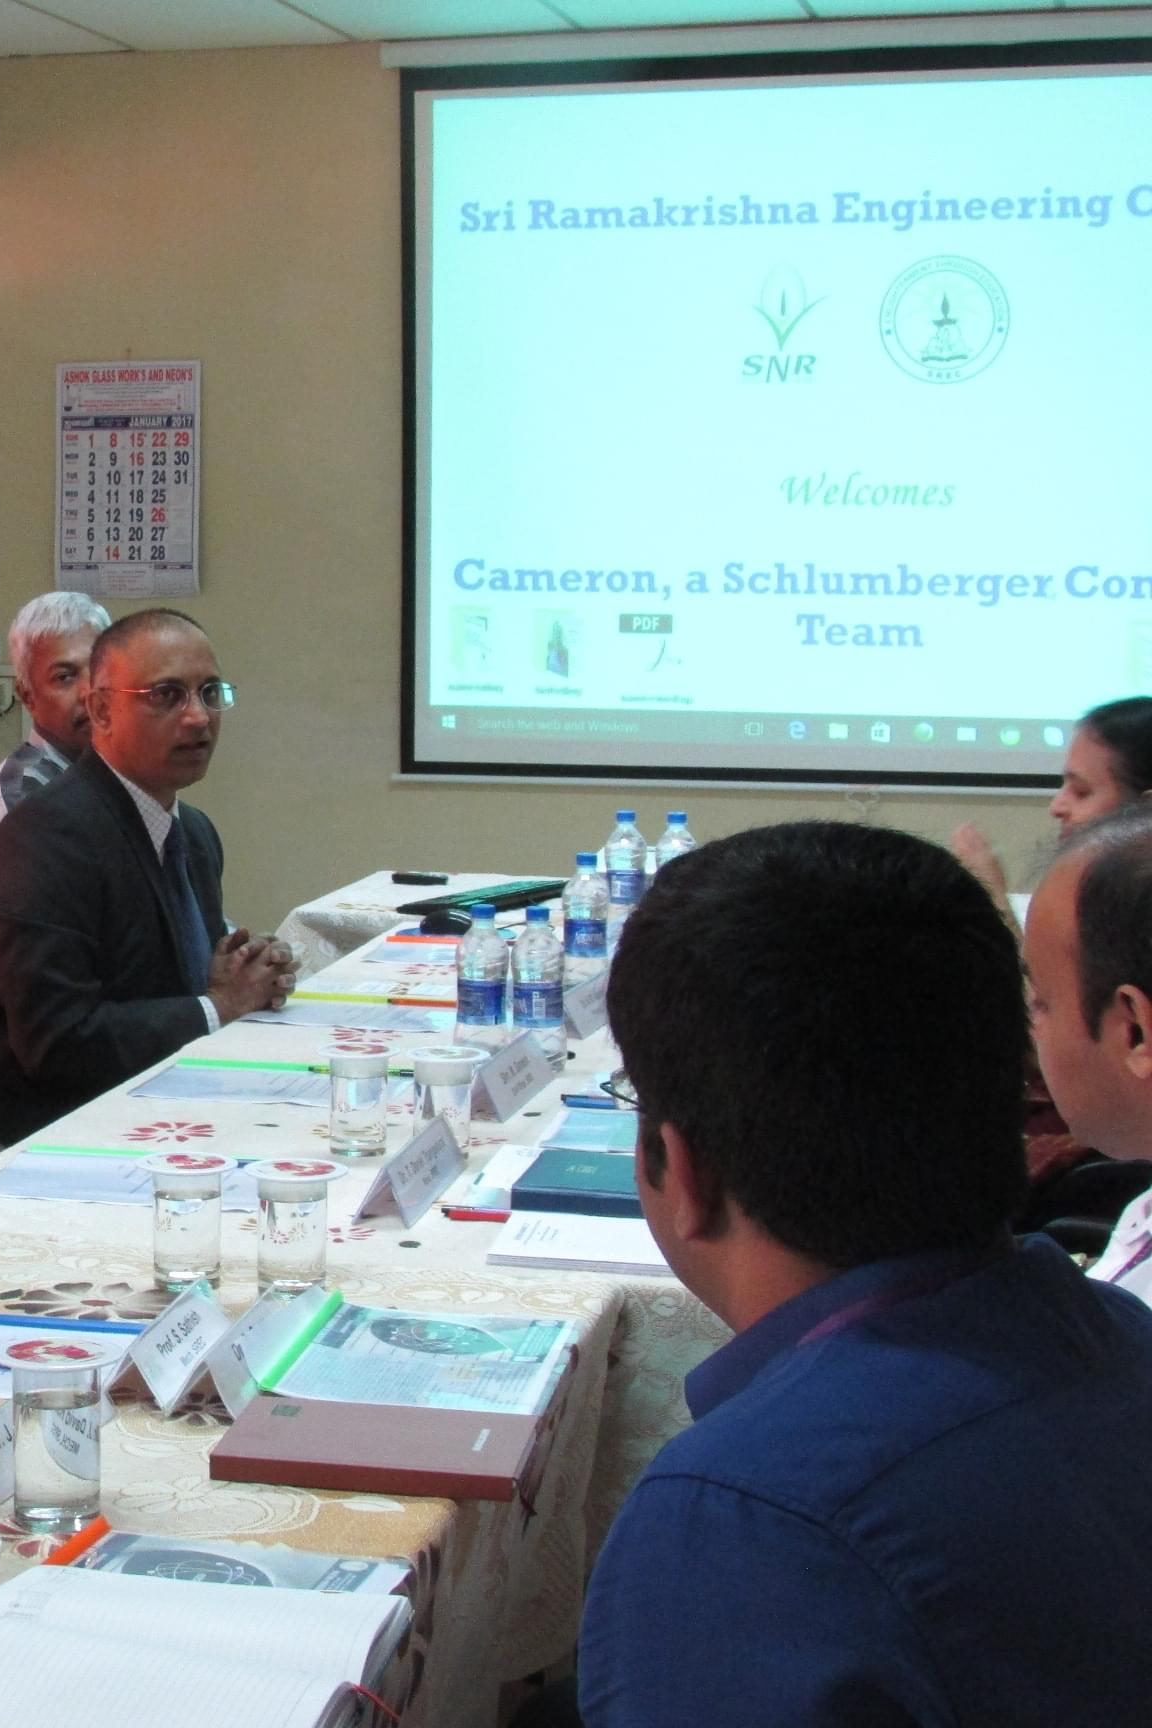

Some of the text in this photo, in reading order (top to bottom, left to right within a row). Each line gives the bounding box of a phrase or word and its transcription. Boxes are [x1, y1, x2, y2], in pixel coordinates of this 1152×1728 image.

[460, 200, 516, 232] Sri
[528, 195, 819, 230] Ramakrishna
[832, 186, 1113, 232] Engineering
[64, 370, 90, 384] ASHOK
[92, 369, 116, 383] GLASS
[148, 368, 164, 382] AND
[741, 354, 817, 383] SNR
[129, 416, 168, 428] JANUARY
[171, 416, 192, 427] 2017
[89, 433, 93, 448] 1
[110, 433, 117, 447] 8
[130, 433, 144, 447] 15
[152, 433, 166, 447] 22
[175, 432, 189, 446] 29
[89, 452, 95, 466] 2
[109, 452, 117, 466] 9
[129, 452, 144, 465] 16
[152, 452, 166, 465] 23
[174, 451, 189, 465] 30
[88, 471, 95, 485] 3
[107, 471, 120, 484] 10
[129, 471, 144, 484] 17
[152, 471, 166, 484] 24
[174, 470, 187, 484] 31
[88, 490, 95, 504] 4
[106, 490, 119, 503] 11
[129, 490, 143, 503] 18
[152, 490, 166, 503] 25
[779, 472, 957, 507] Welcomes
[88, 509, 94, 522] 5
[106, 509, 120, 522] 12
[129, 509, 143, 522] 19
[151, 508, 165, 522] 26
[87, 528, 94, 541] 6
[106, 528, 120, 541] 13
[129, 527, 143, 541] 20
[151, 527, 165, 541] 27
[88, 547, 94, 560] 7
[105, 547, 120, 560] 14
[129, 547, 141, 560] 21
[151, 546, 165, 560] 28
[453, 558, 672, 600] Cameron,
[686, 570, 710, 593] a
[723, 562, 1054, 608] Schlumberger
[632, 616, 660, 631] PDF
[796, 613, 924, 648] Team
[589, 719, 640, 733] Windows
[156, 1334, 177, 1359] Prof.
